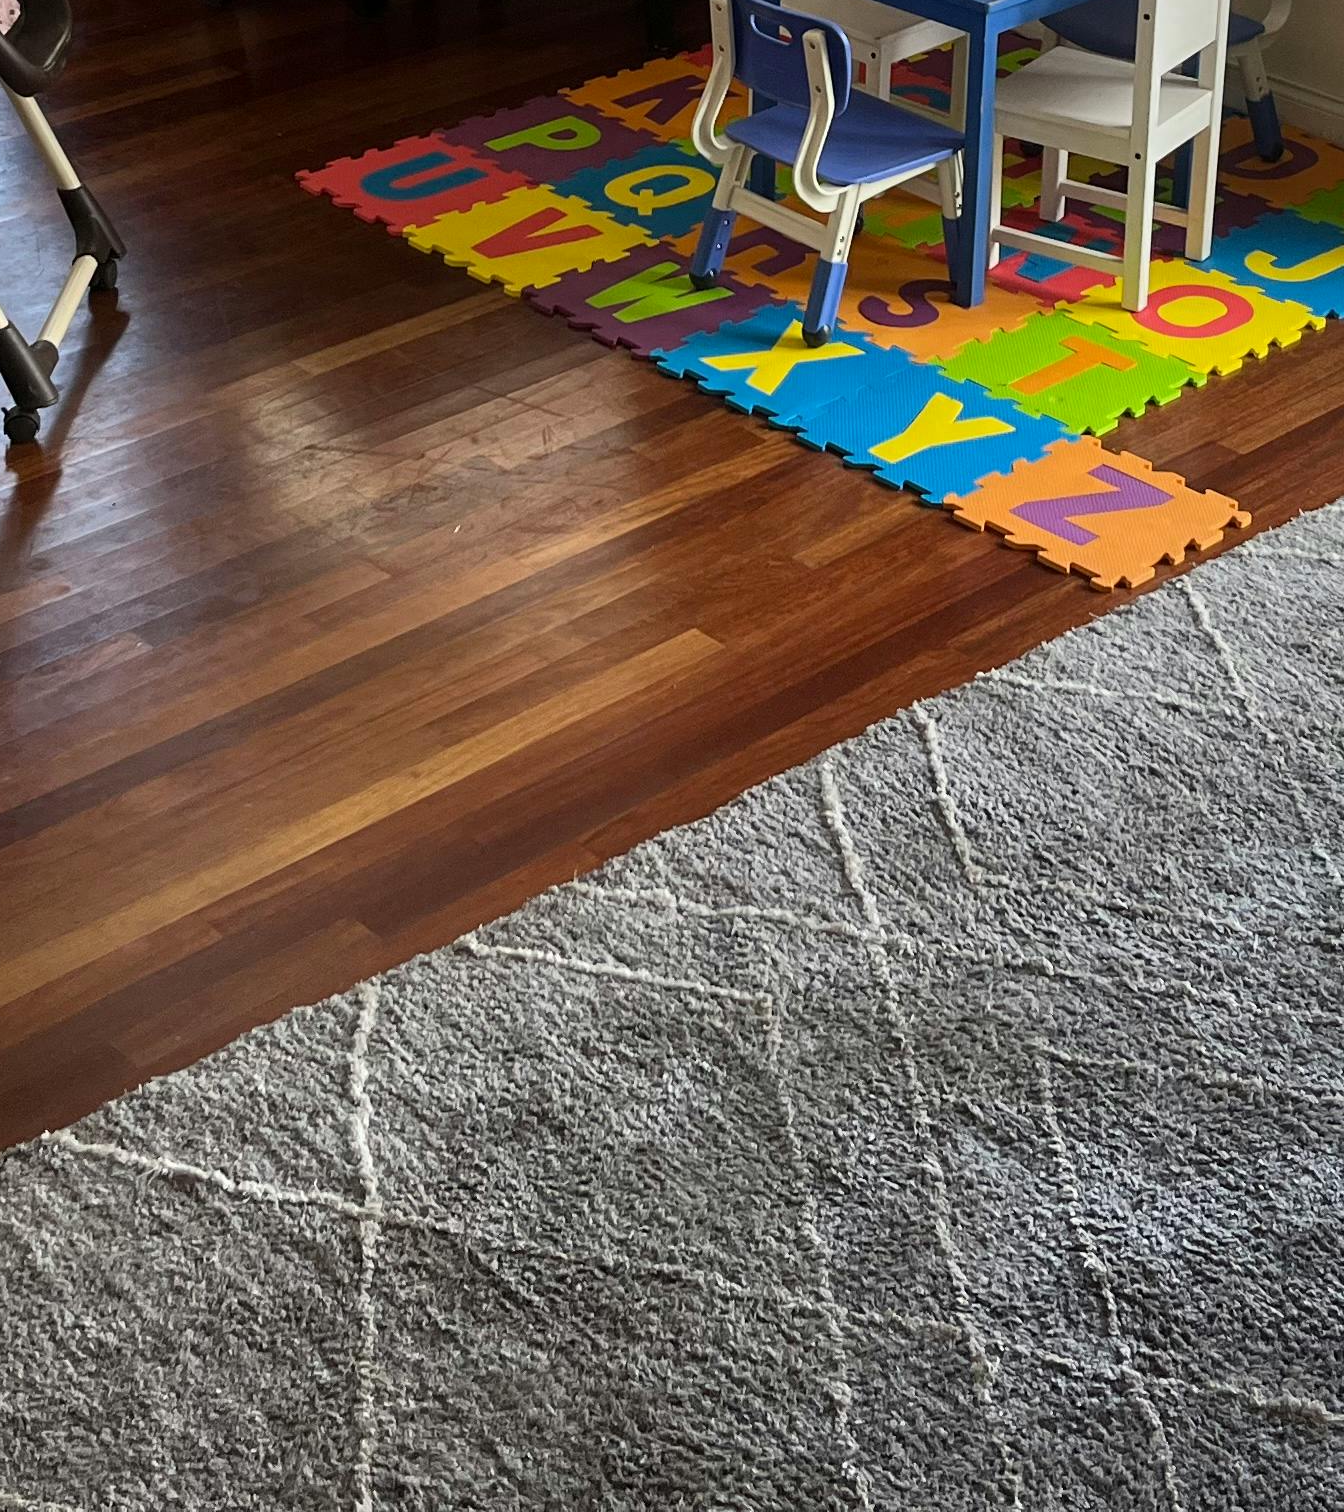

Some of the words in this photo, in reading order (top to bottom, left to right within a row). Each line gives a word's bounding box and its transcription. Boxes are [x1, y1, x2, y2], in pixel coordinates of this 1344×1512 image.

[484, 115, 601, 152] P
[361, 151, 487, 202] U
[605, 164, 716, 216] Q
[471, 206, 604, 259] V
[585, 260, 735, 324] W
[859, 279, 957, 328] S
[1131, 284, 1255, 338] O
[700, 319, 866, 396] X
[1009, 335, 1137, 395] T
[869, 392, 1015, 464] Y
[1011, 463, 1175, 546] Z
